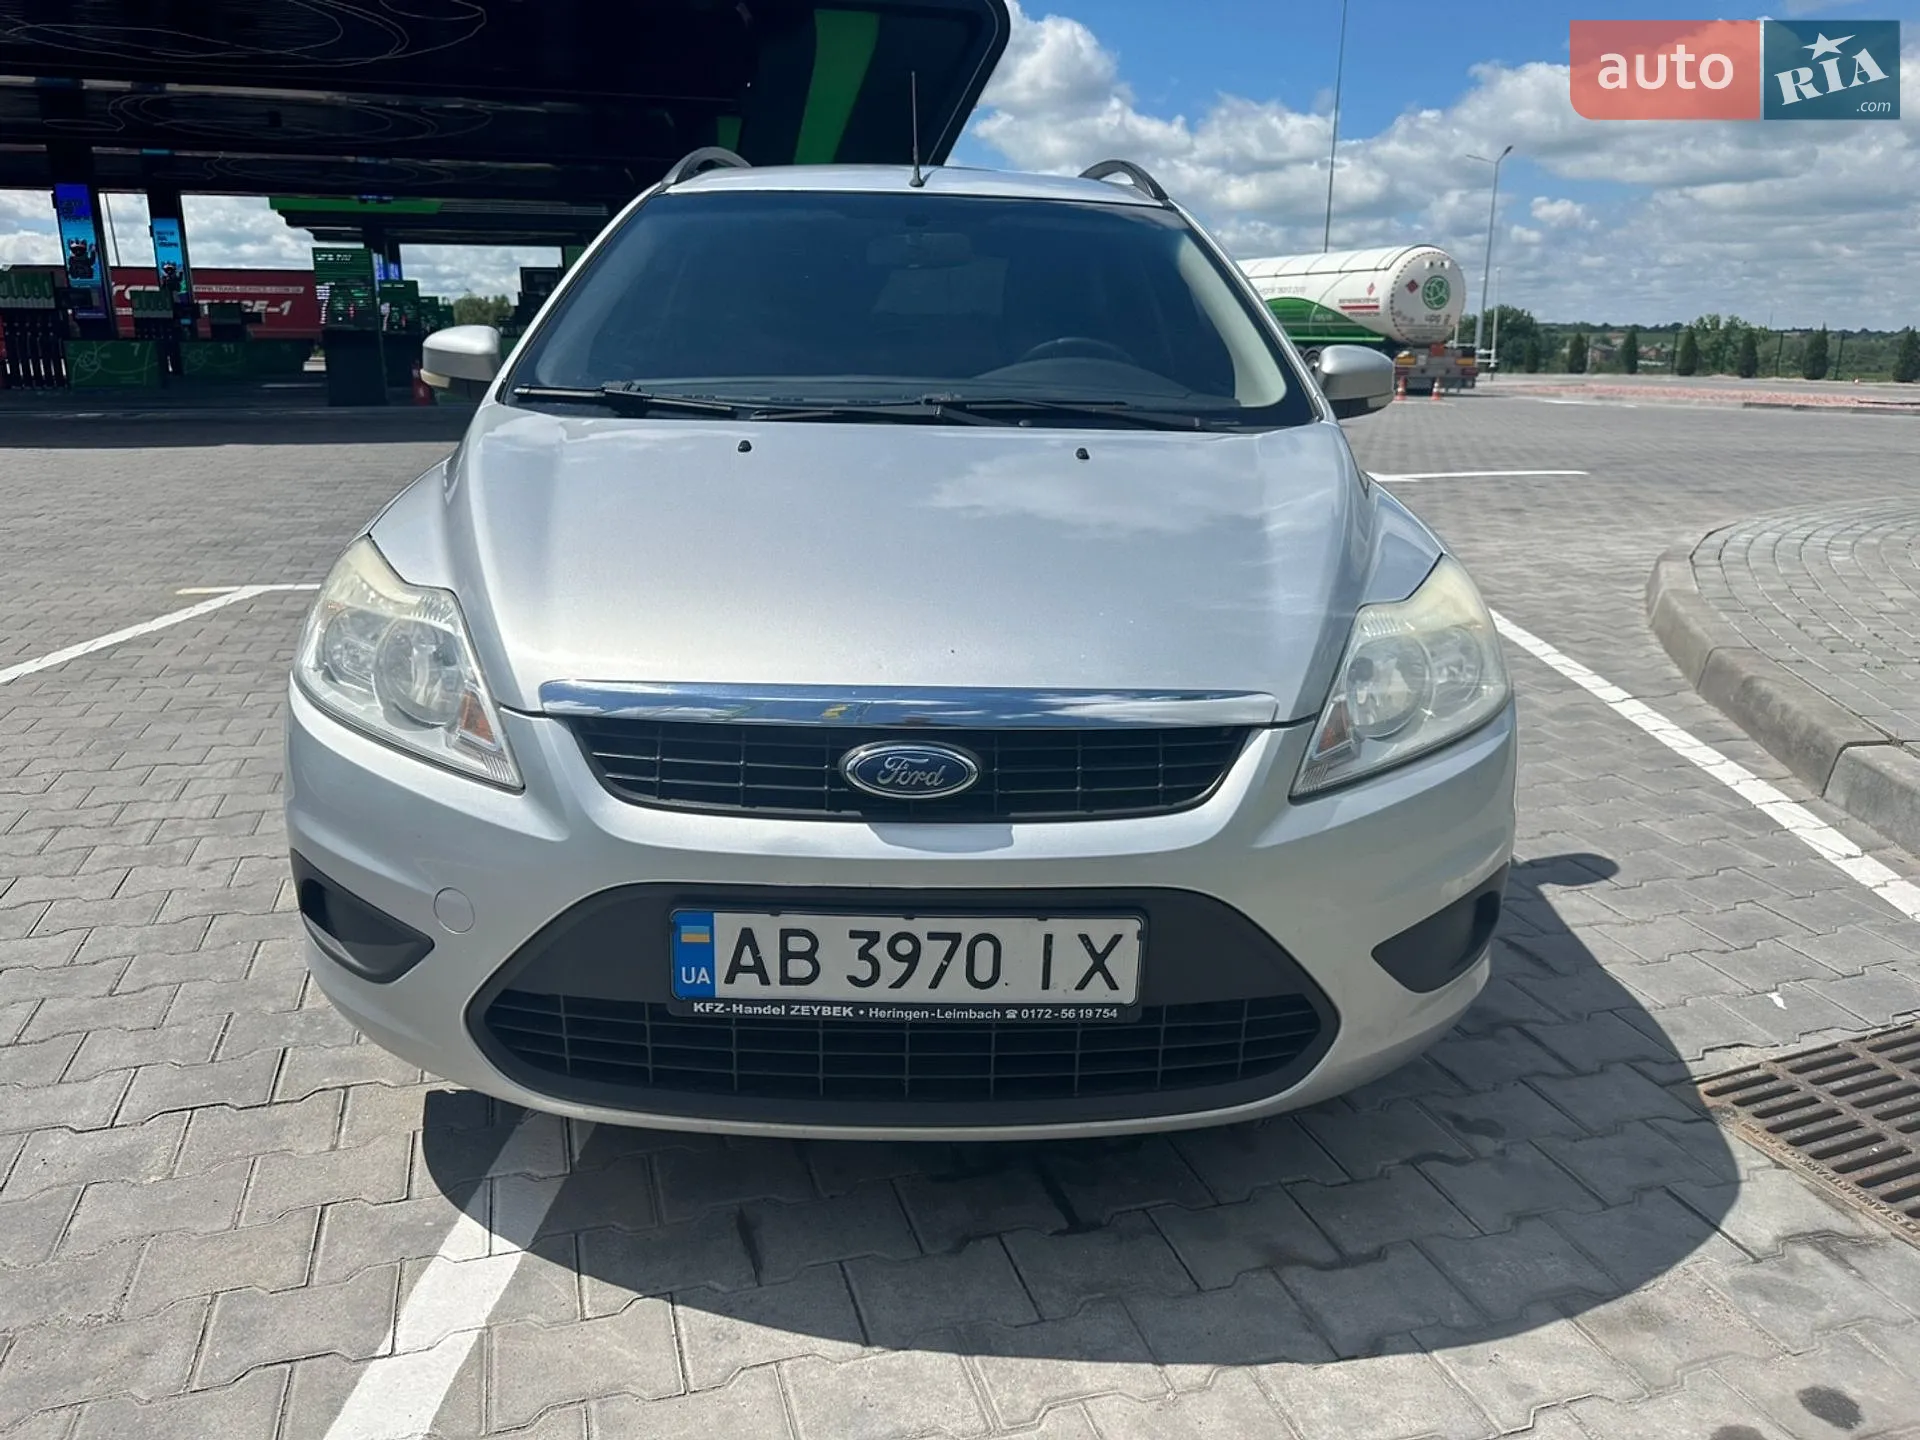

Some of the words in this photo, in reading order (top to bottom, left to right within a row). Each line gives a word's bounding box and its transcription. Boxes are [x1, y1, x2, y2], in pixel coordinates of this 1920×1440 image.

[877, 755, 946, 787] Ford
[724, 927, 821, 987] AB
[846, 929, 1002, 990] 3970
[681, 967, 711, 986] UA
[693, 1002, 785, 1016] KFZ-Handel
[789, 1005, 854, 1018] ZEYBEK
[868, 1007, 1001, 1021] Heringen-Leimbach
